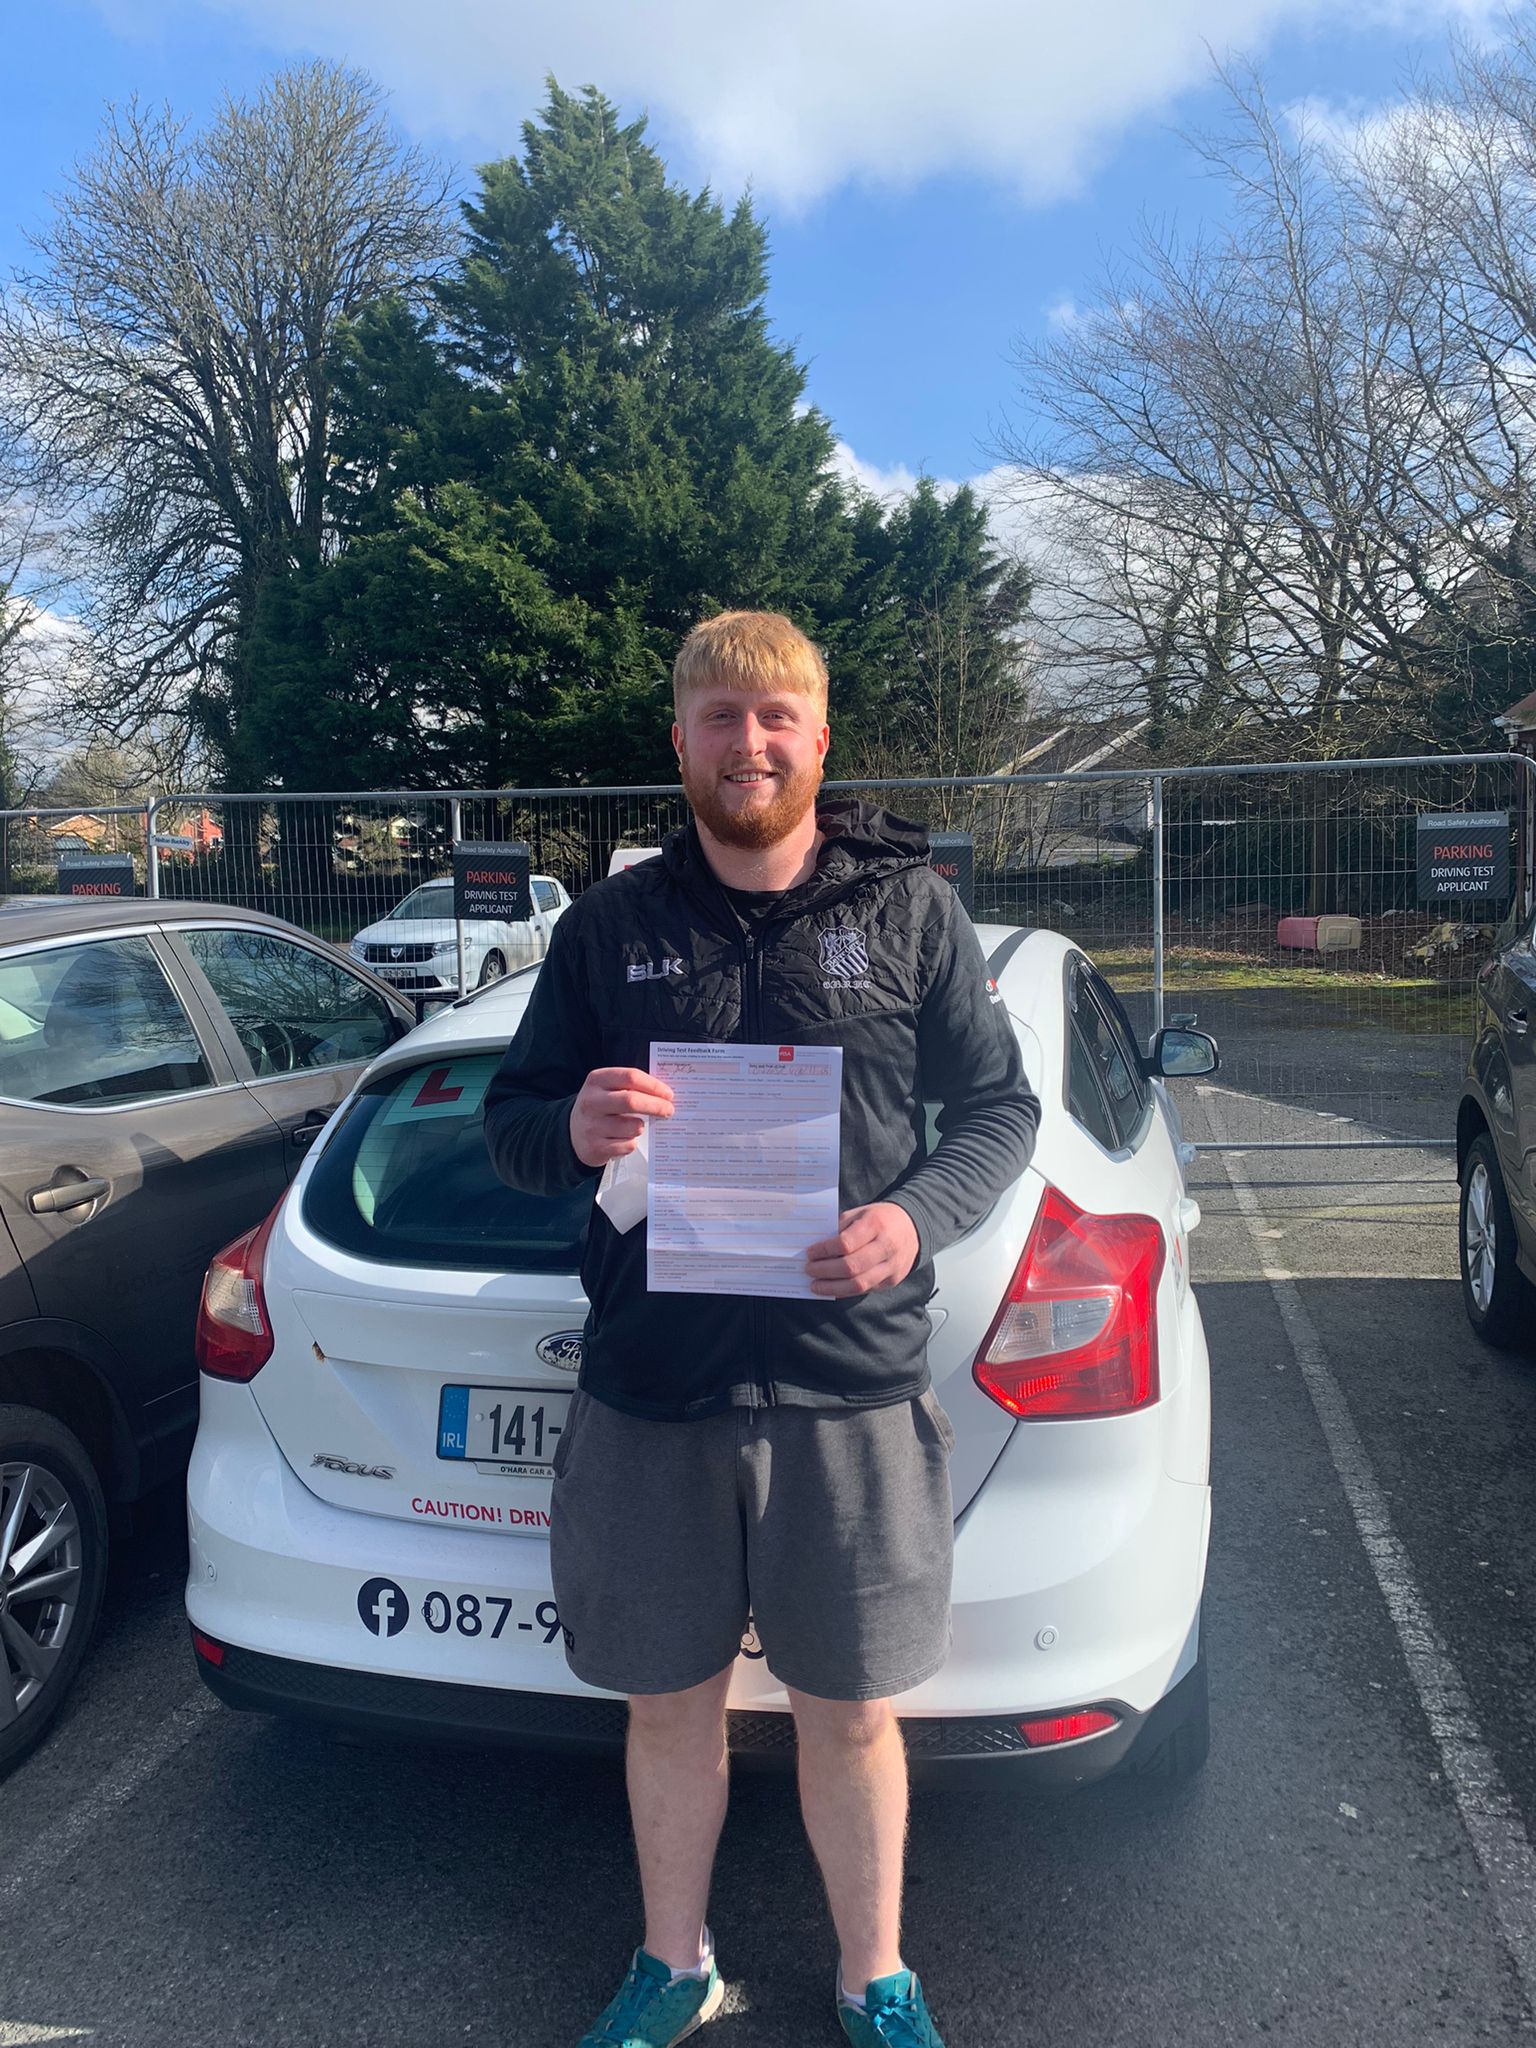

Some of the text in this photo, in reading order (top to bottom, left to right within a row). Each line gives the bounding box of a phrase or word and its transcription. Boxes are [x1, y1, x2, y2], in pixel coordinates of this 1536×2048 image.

[1427, 818, 1500, 828] Road Safety Authority
[477, 846, 496, 855] Safety
[496, 847, 522, 855] Authority
[1433, 844, 1493, 860] PARKING
[65, 860, 81, 868] Road
[82, 860, 100, 868] Safety
[466, 871, 517, 885] PARKING
[1431, 865, 1496, 878] DRIVING TEST
[72, 882, 121, 895] PARKING
[1436, 880, 1490, 892] APPLICANT
[464, 890, 519, 901] DRIVING TEST
[469, 903, 513, 914] APPLICANT
[626, 957, 684, 983] BLK
[411, 1066, 464, 1108] L
[442, 1431, 464, 1449] IRL
[500, 1466, 528, 1475] O'HARA
[529, 1467, 545, 1476] CAR
[411, 1497, 503, 1523] CAUTION!
